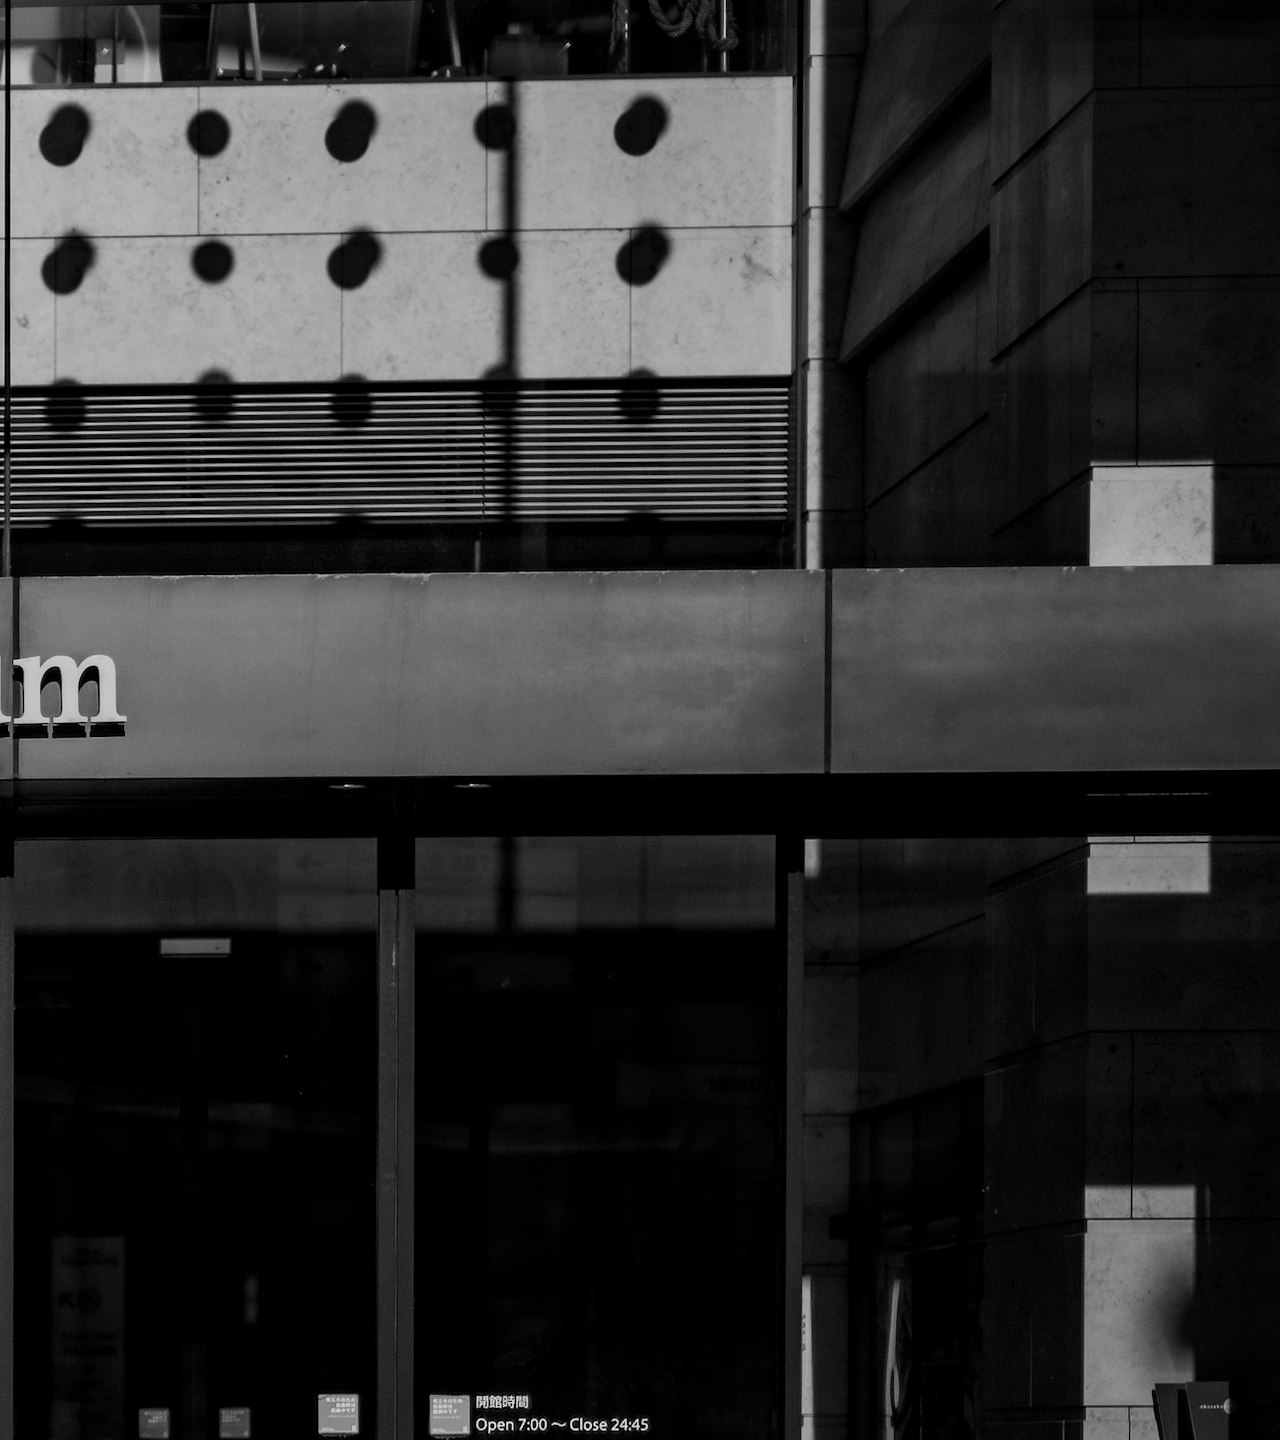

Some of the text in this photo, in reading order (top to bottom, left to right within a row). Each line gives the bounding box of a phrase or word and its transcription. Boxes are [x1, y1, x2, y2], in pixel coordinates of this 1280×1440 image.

[475, 1395, 530, 1409] 開館時間
[475, 1417, 515, 1434] Open
[517, 1418, 548, 1432] 7:00
[569, 1417, 608, 1432] Close
[610, 1418, 649, 1432] 24:45
